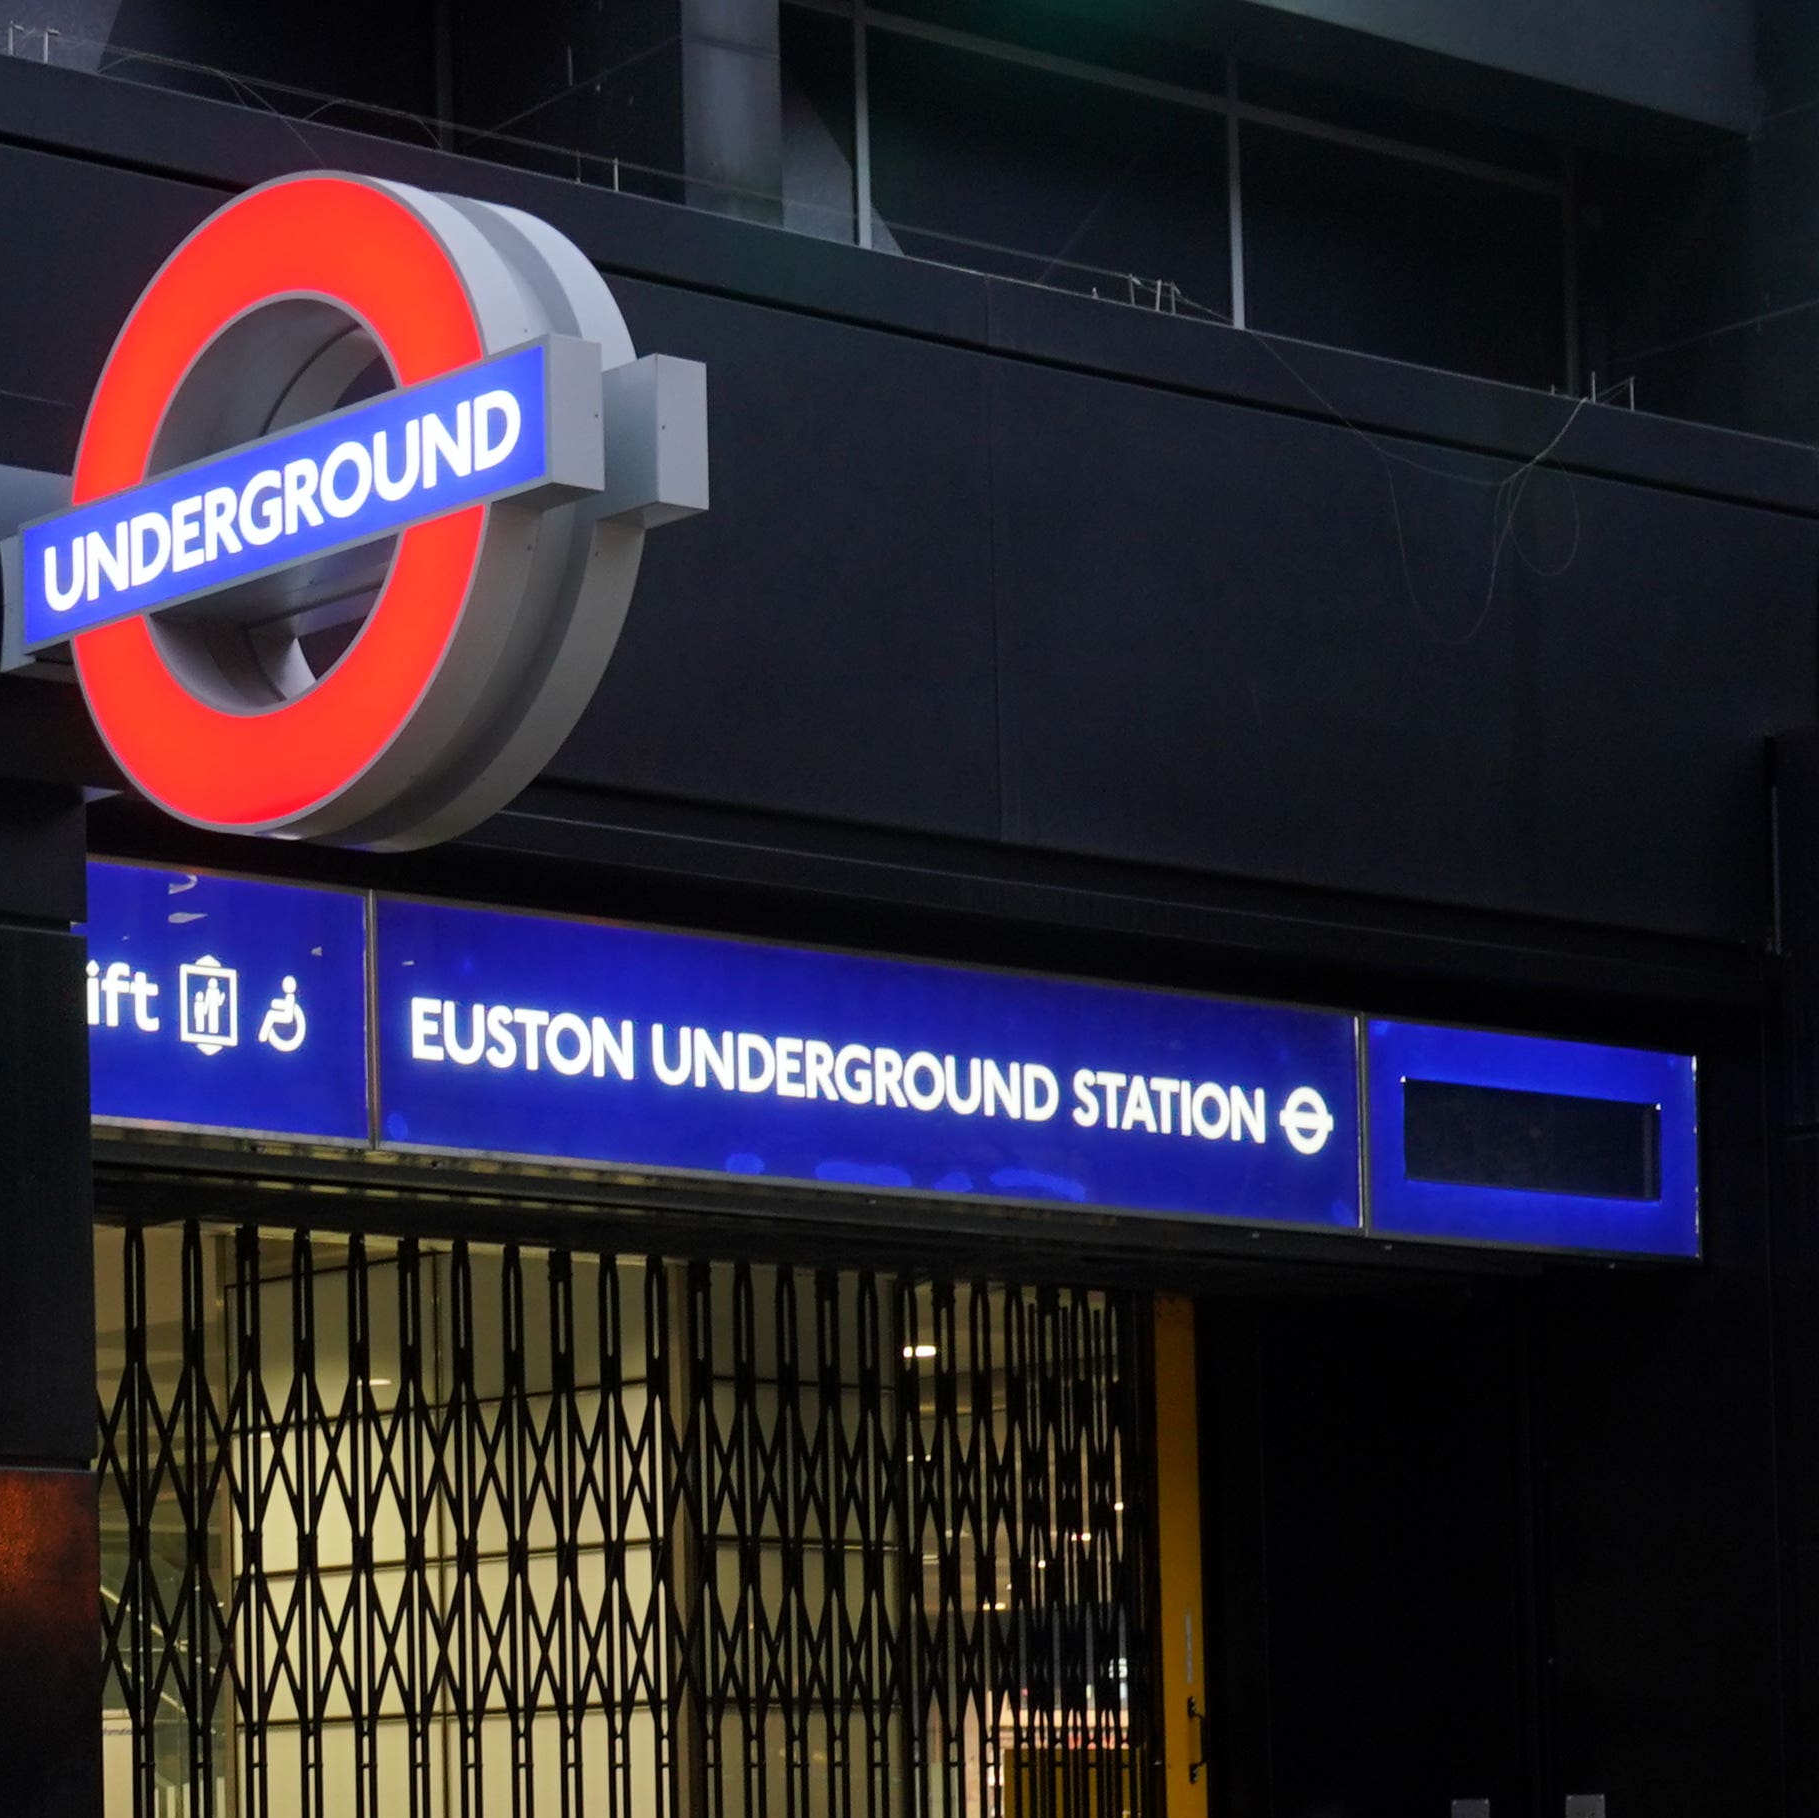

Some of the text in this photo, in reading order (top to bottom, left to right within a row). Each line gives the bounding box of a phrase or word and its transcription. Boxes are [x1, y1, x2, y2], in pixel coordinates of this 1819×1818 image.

[43, 389, 523, 613] UNDERGROUND
[85, 959, 160, 1032] ift
[409, 996, 1266, 1144] EUSTON UNDERGROUND STATION
